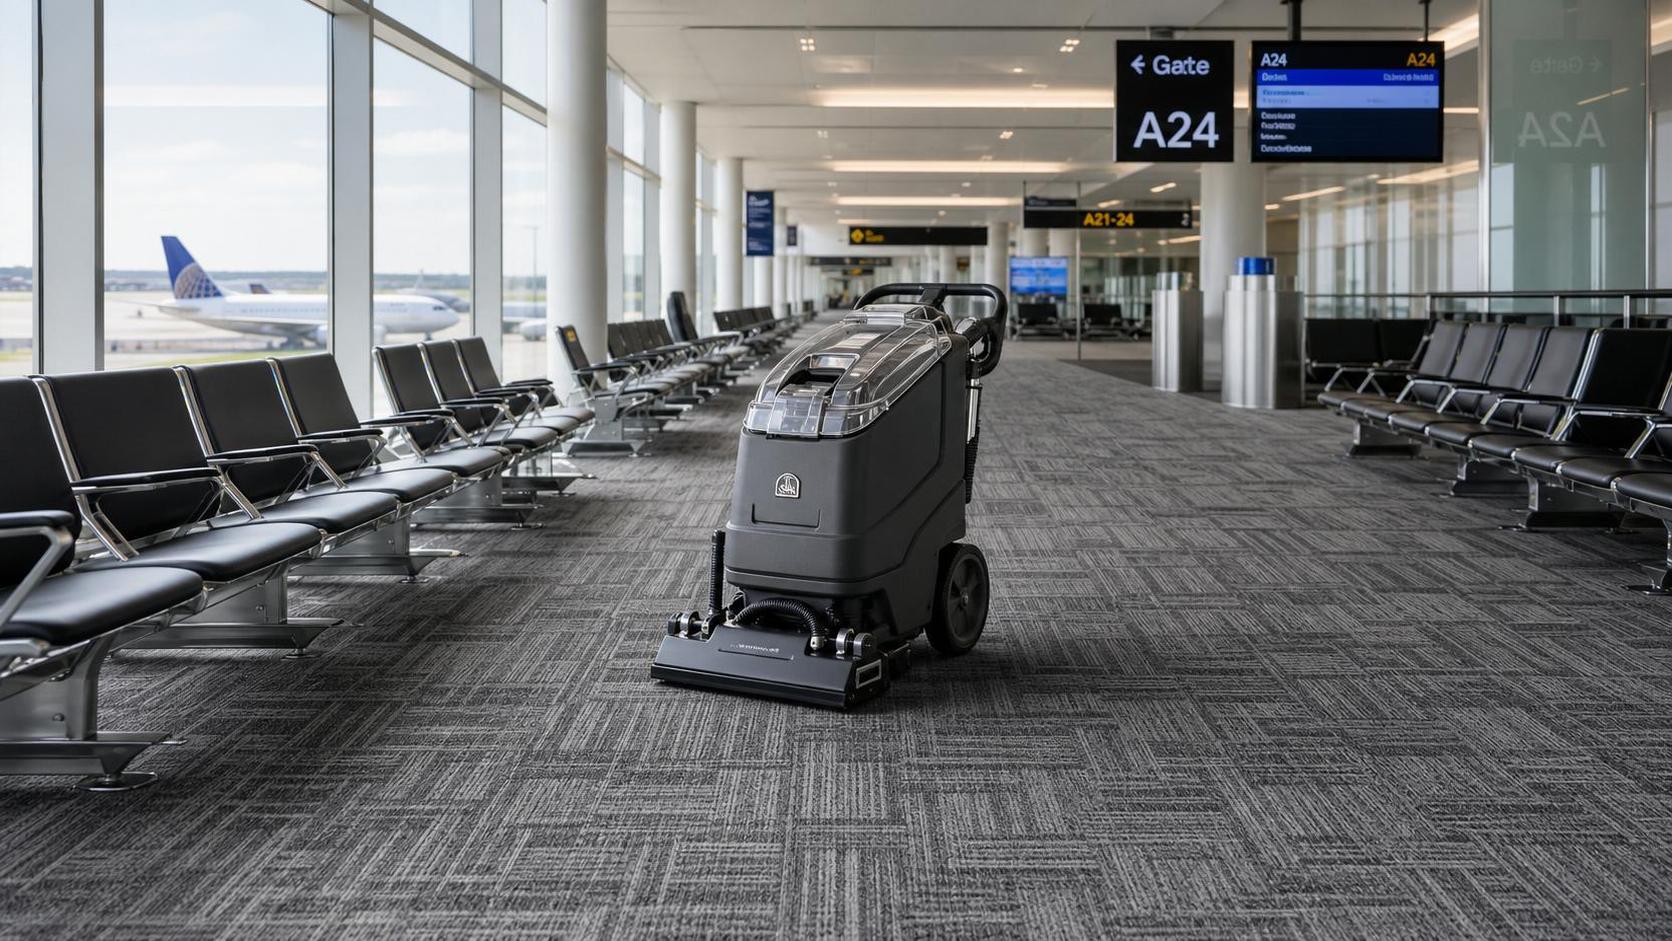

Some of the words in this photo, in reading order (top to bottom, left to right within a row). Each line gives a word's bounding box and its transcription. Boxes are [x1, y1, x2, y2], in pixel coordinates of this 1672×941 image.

[1152, 54, 1210, 76] Gate
[1260, 52, 1288, 67] A24
[1406, 52, 1436, 67] A24
[1133, 110, 1220, 149] A24
[1083, 212, 1135, 227] A21-24
